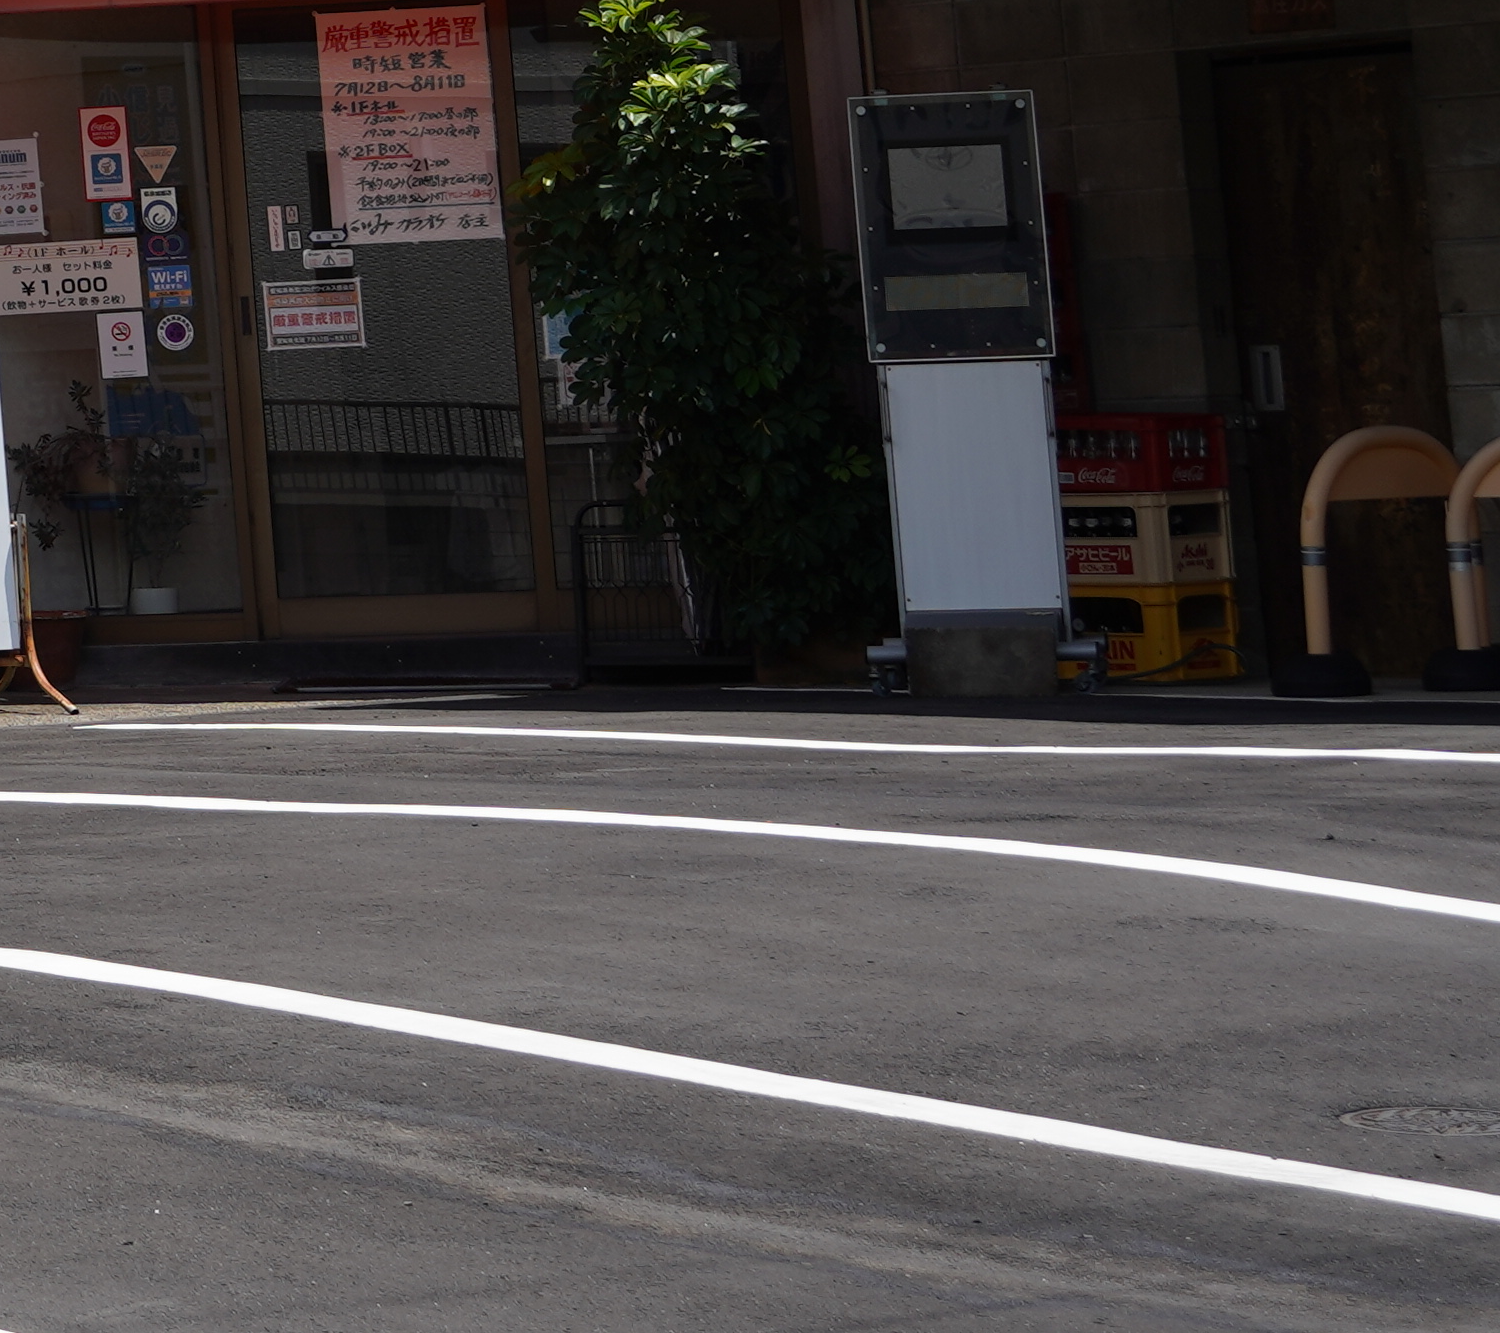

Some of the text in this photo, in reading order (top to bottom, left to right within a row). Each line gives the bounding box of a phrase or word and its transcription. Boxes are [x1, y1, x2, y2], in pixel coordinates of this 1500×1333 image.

[322, 17, 480, 53] 厳重警戒措置
[63, 260, 113, 272] セット料金
[151, 270, 188, 284] Wi-Fi
[21, 276, 108, 297] ¥1,000
[1078, 467, 1117, 484] Coca-Cola
